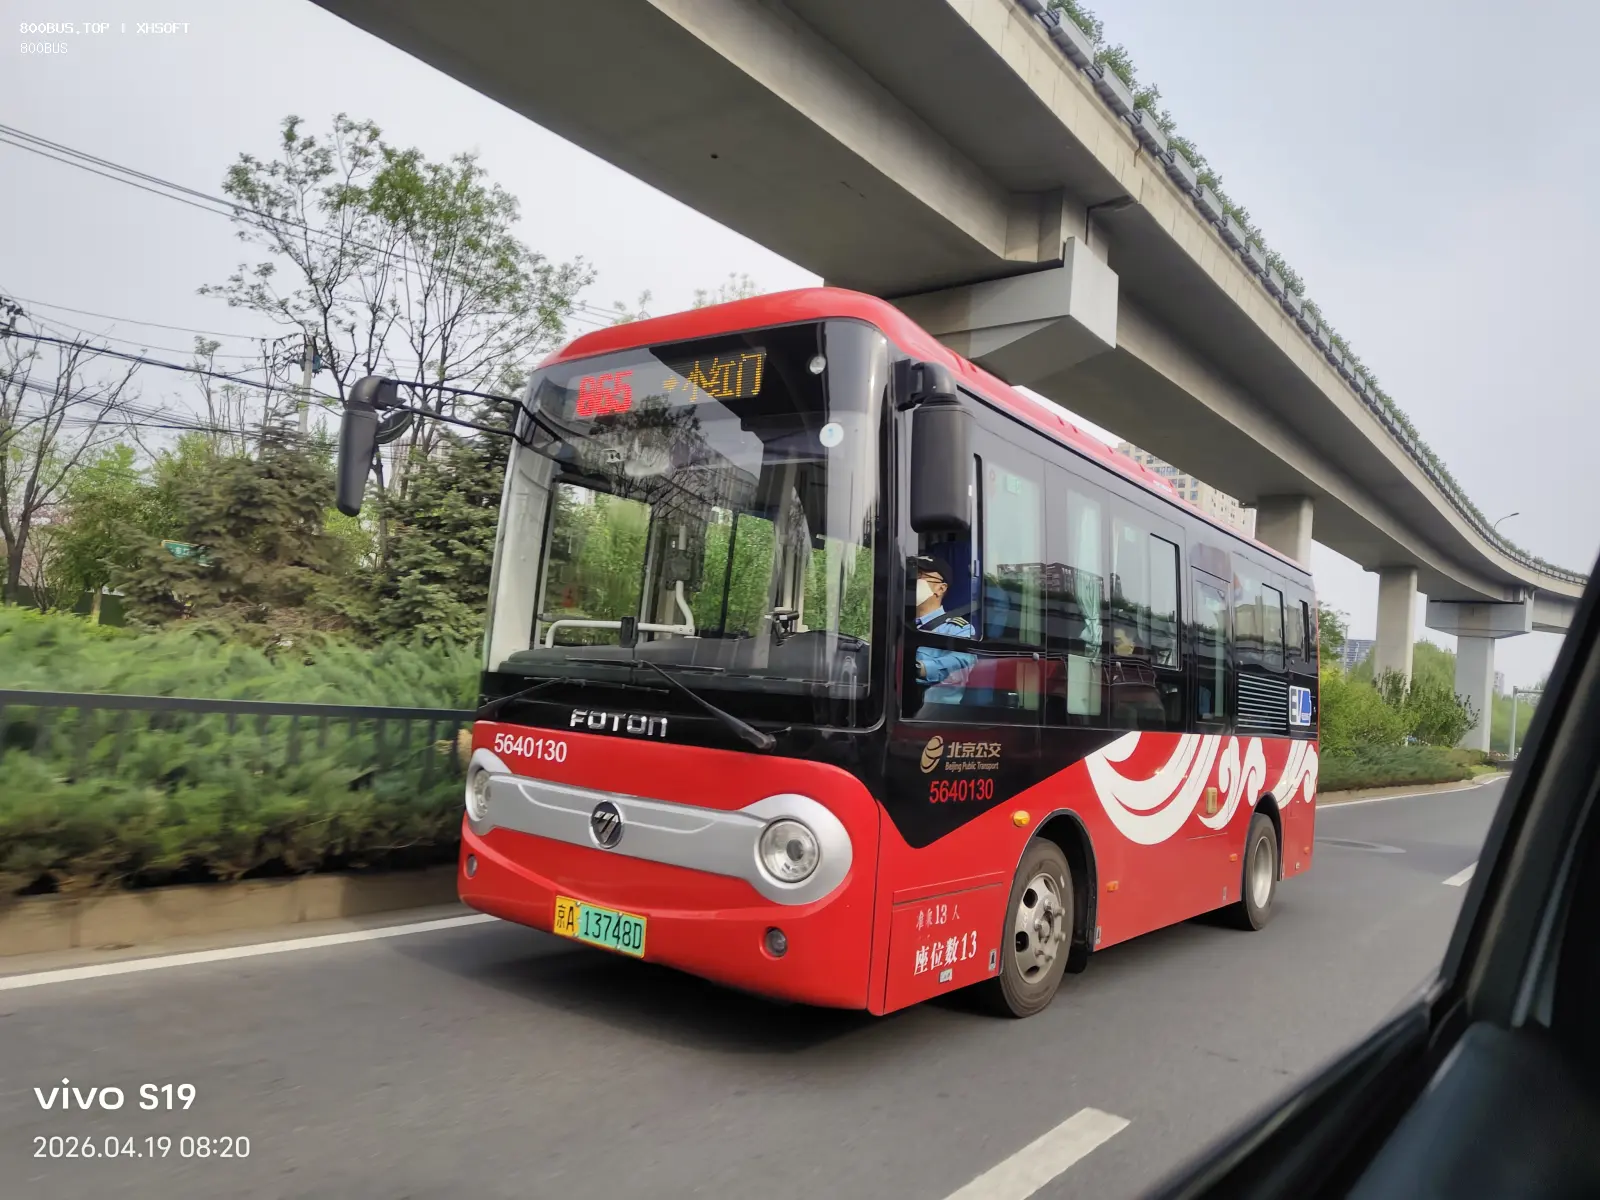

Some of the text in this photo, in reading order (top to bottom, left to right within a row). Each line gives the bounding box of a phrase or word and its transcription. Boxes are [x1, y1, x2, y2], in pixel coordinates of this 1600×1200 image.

[575, 370, 634, 417] 865
[569, 708, 668, 738] FOTON
[494, 732, 567, 763] 5640130
[946, 741, 1002, 758] 北京公交
[945, 761, 999, 772] Beijing Public Transport
[929, 778, 994, 804] 5640130
